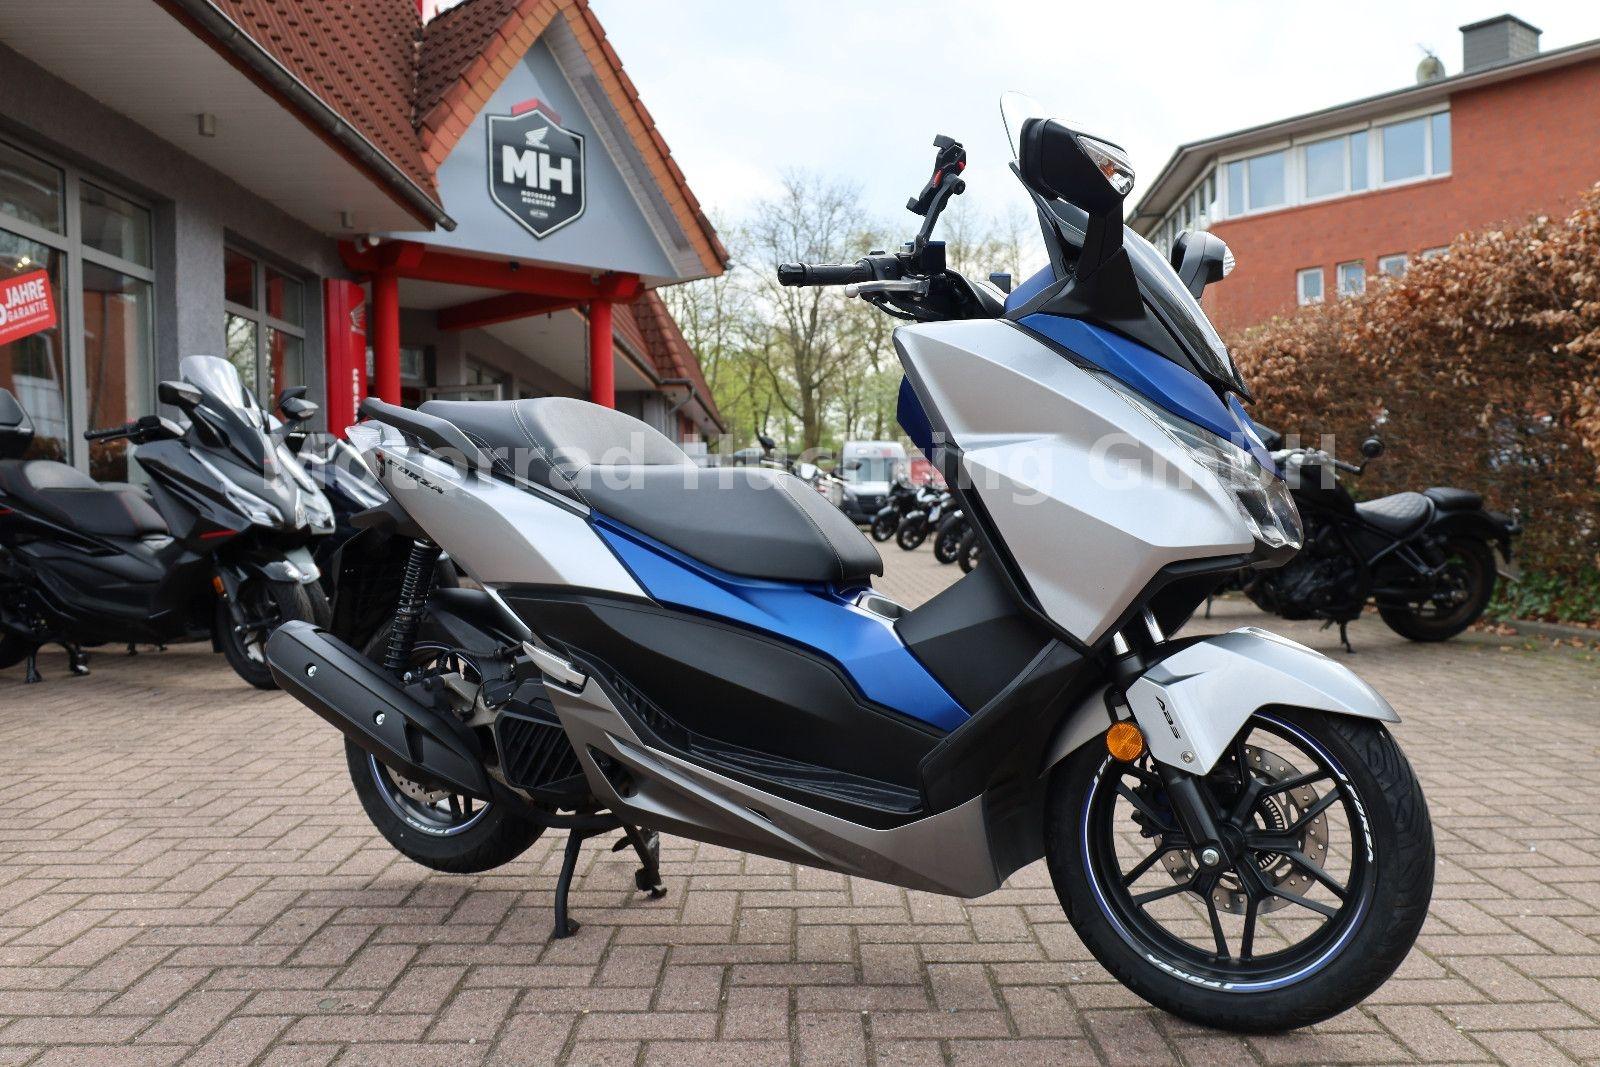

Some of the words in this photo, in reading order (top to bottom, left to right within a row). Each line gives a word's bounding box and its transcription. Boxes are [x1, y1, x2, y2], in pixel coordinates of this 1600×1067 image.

[502, 145, 573, 195] MH
[5, 278, 47, 309] JAHRE
[7, 299, 49, 322] GARANTIE
[1345, 784, 1374, 863] FORZA
[1147, 954, 1222, 988] FORZA
